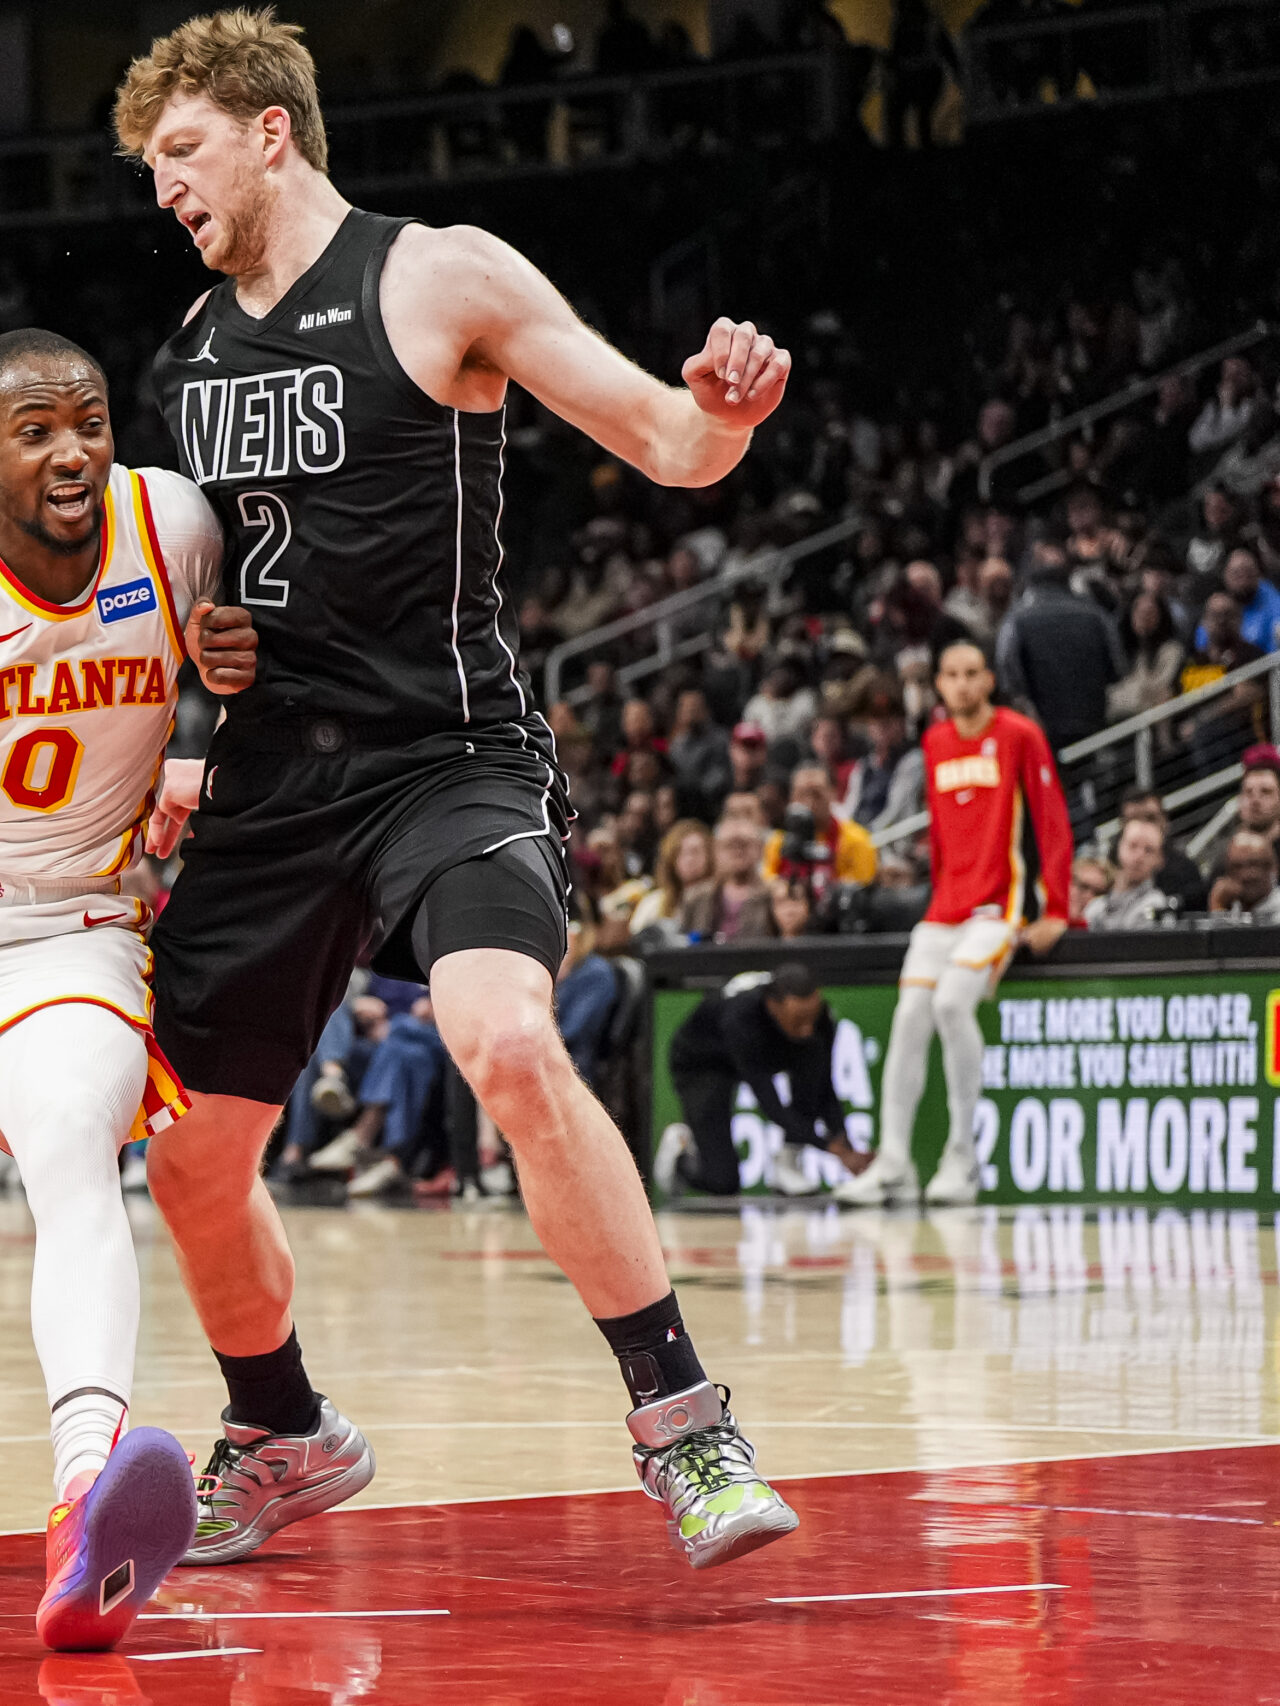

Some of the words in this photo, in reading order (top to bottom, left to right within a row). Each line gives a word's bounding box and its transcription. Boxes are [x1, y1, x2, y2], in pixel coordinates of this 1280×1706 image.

[299, 314, 315, 330] All
[316, 312, 327, 326] In
[327, 307, 352, 323] Won
[181, 364, 346, 486] NETS
[237, 491, 292, 608] 2
[100, 587, 150, 616] paze
[0, 726, 86, 815] 0
[999, 999, 1043, 1043] THE
[1045, 998, 1114, 1041] MORE
[1116, 996, 1164, 1041] YOU
[981, 1045, 1006, 1089] HE
[1008, 1044, 1076, 1089] MORE
[1078, 1044, 1125, 1088] YOU
[1128, 1042, 1188, 1088] SAVE
[1189, 1042, 1257, 1086] WITH
[1009, 1096, 1085, 1192] OR
[1095, 1096, 1259, 1193] MORE
